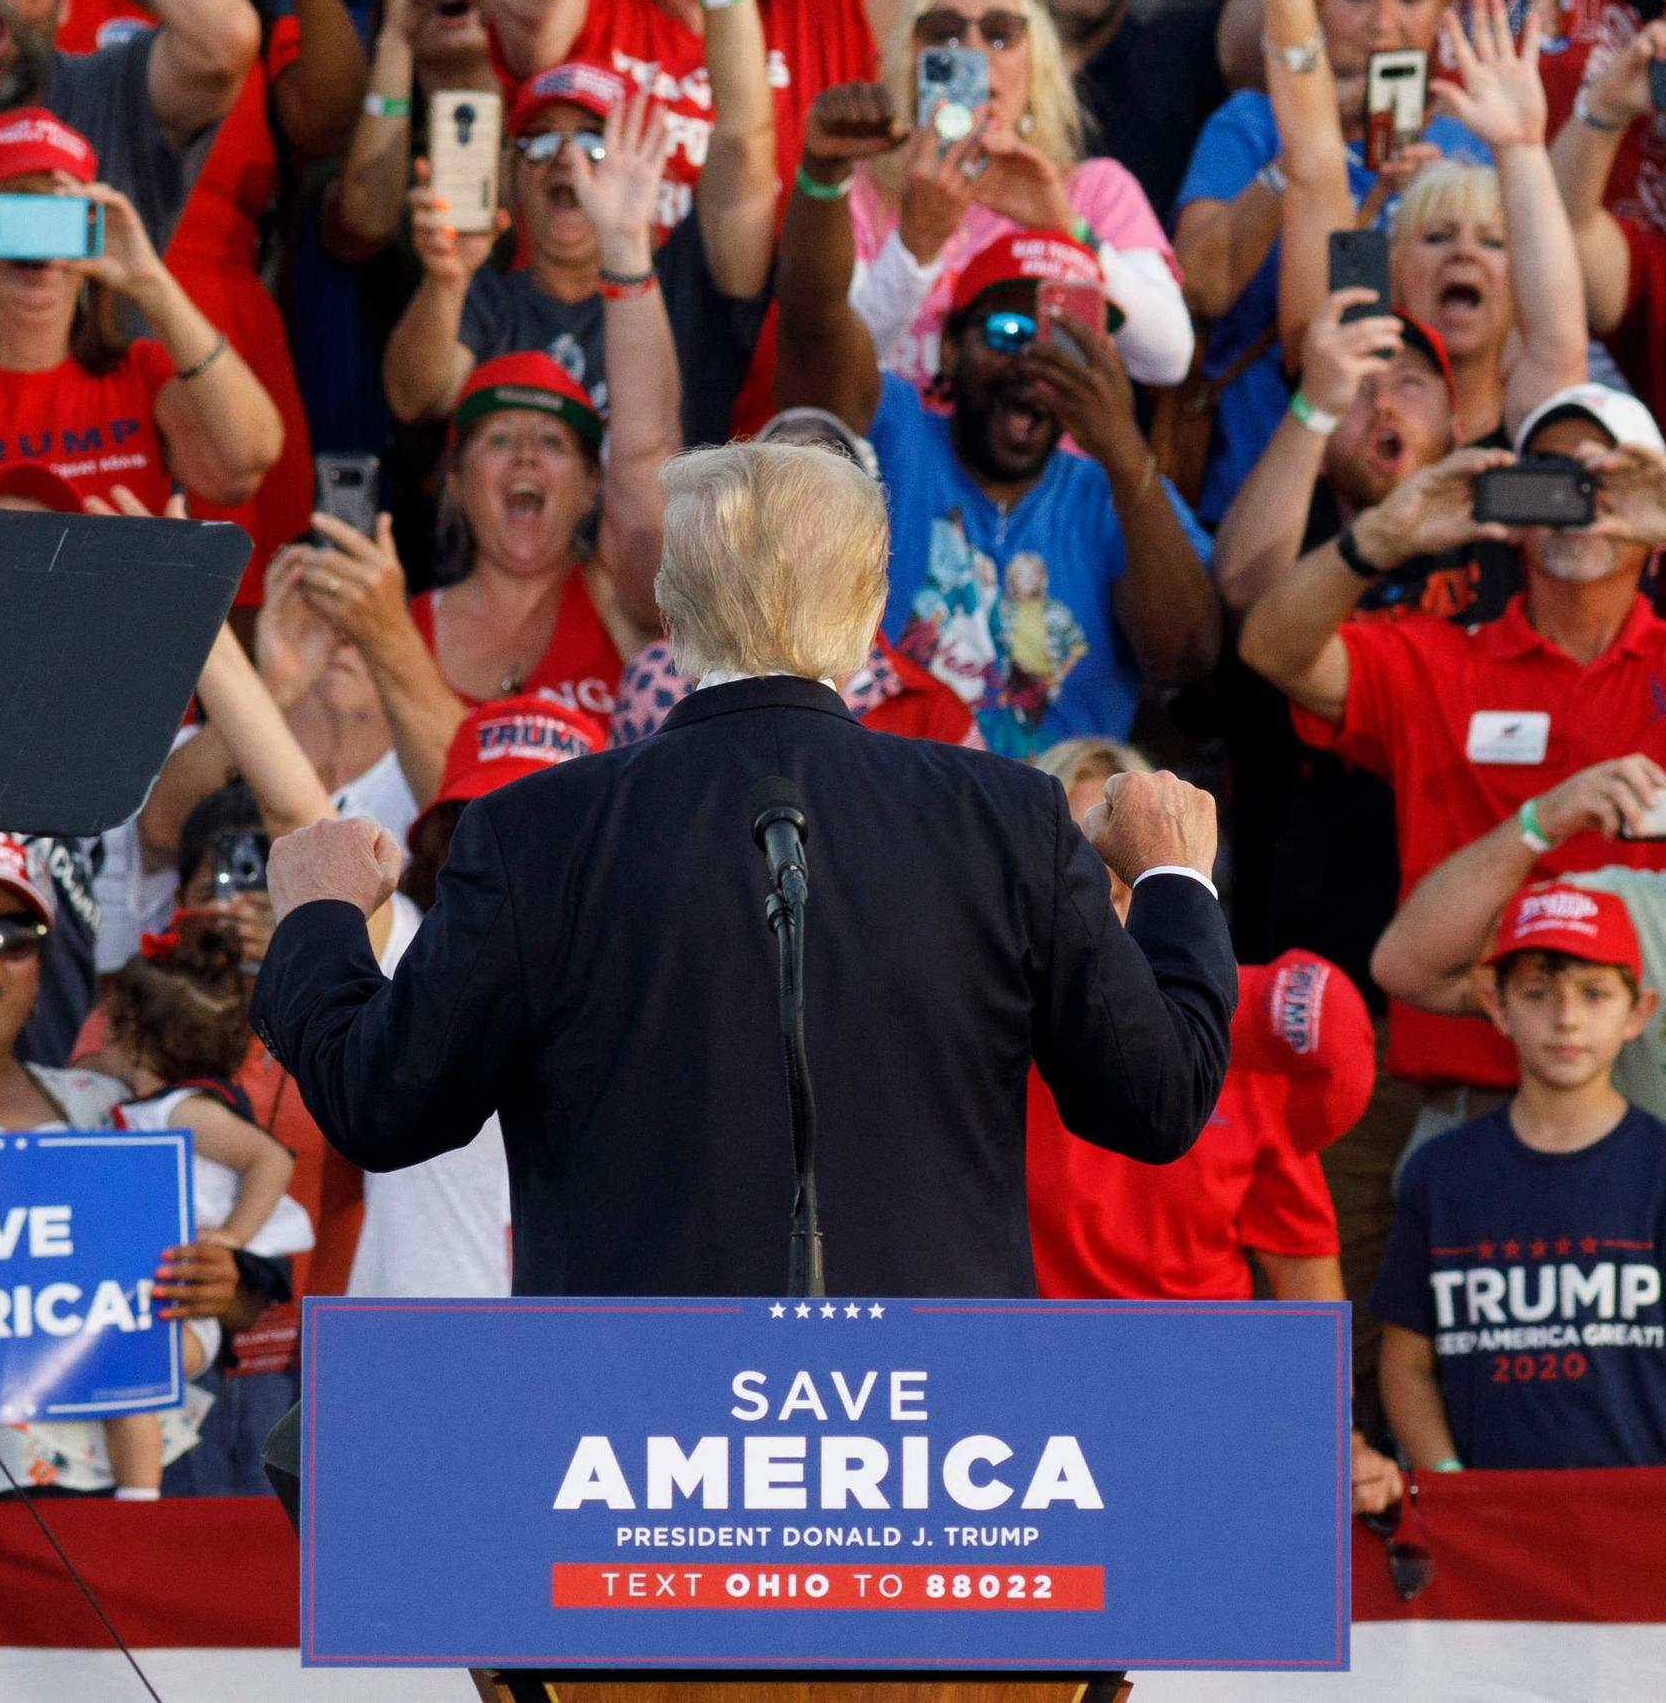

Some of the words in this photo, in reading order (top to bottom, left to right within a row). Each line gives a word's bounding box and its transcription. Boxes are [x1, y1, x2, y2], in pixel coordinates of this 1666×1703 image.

[1281, 963, 1314, 1053] TRUMP
[1430, 1262, 1661, 1328] TRUMP
[1476, 1323, 1580, 1351] AMERICA
[1581, 1321, 1665, 1348] GREAT!
[1490, 1352, 1589, 1383] 2020
[731, 1370, 929, 1421] SAVE
[552, 1434, 1104, 1511] AMERICA
[616, 1526, 771, 1548] PRESIDENT
[781, 1526, 902, 1548] DONALD
[911, 1526, 934, 1548] J.
[943, 1526, 1039, 1548] TRUMP
[602, 1573, 701, 1598] TEXT
[725, 1573, 830, 1599] OHIO
[854, 1573, 903, 1599] TO
[925, 1573, 1053, 1600] 88022
